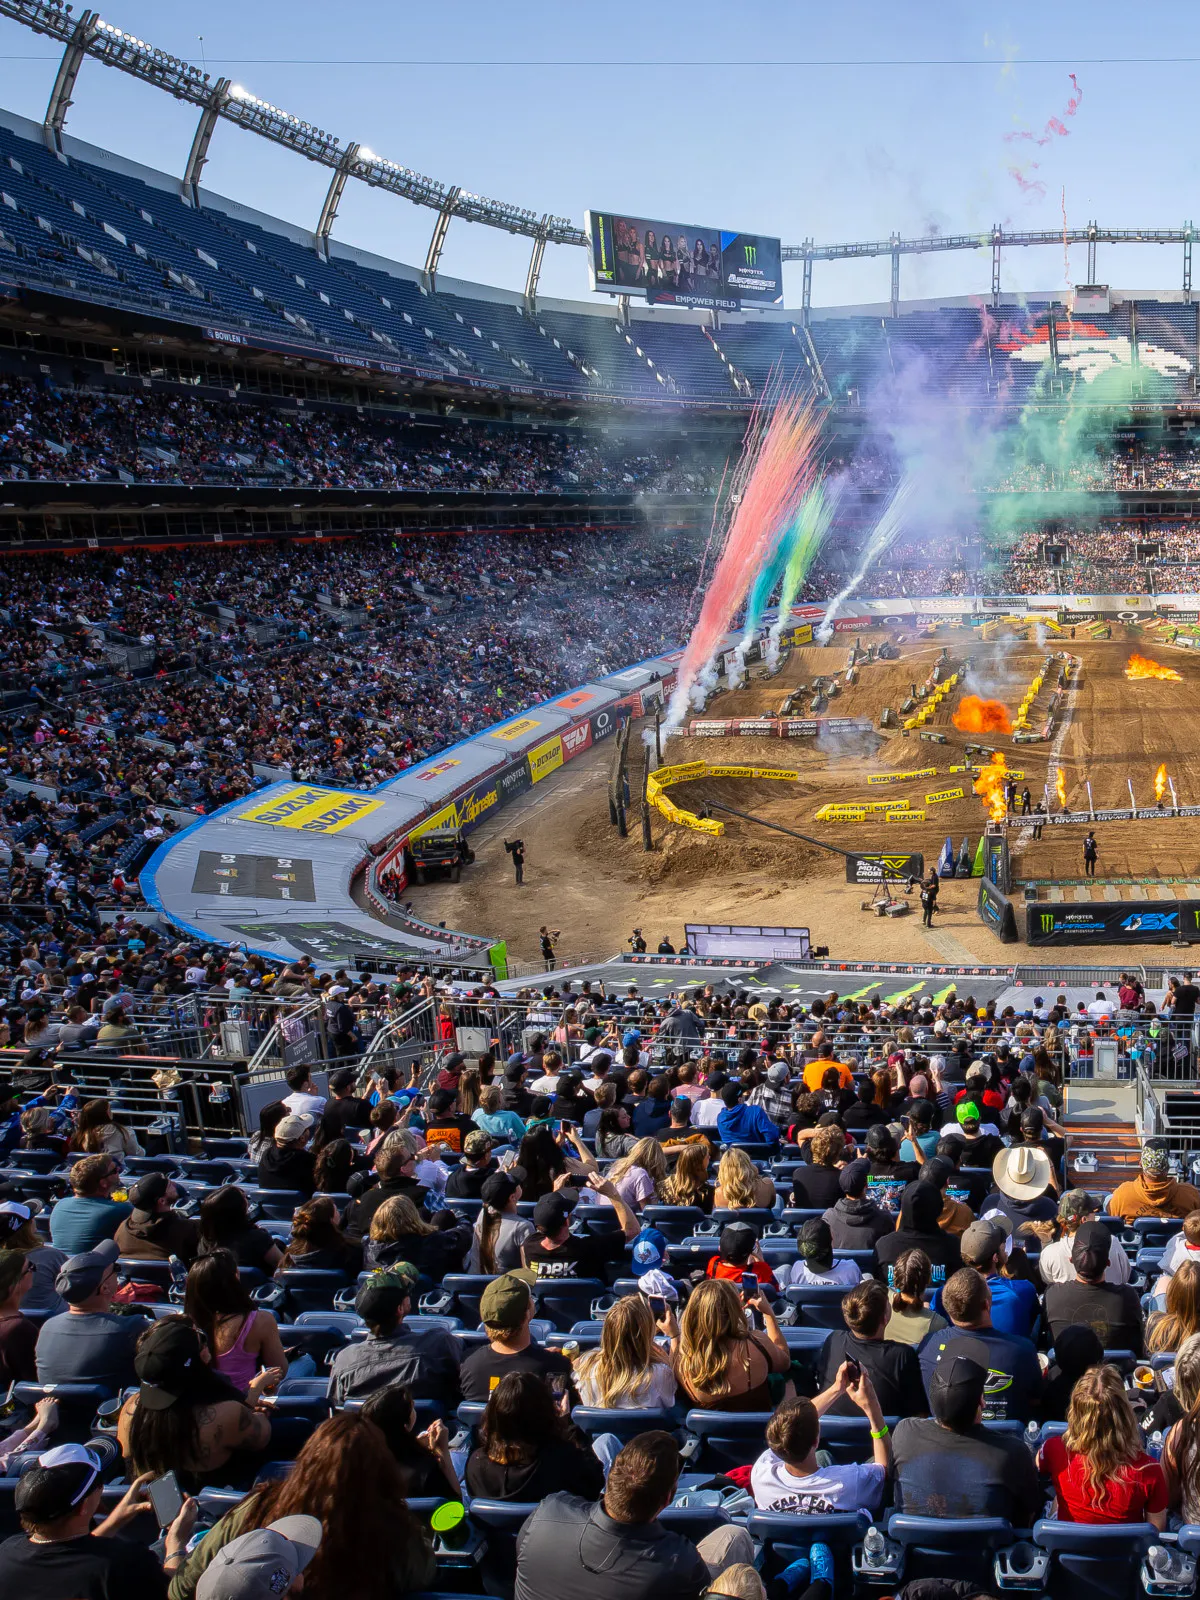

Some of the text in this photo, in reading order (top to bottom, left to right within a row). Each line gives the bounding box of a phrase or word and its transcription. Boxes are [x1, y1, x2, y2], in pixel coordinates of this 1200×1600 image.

[675, 295, 737, 308] EMPOWER FIELD
[215, 331, 241, 343] BOWLEN
[563, 723, 589, 749] FLY
[595, 724, 613, 740] OAKLEY
[536, 745, 561, 768] DUNLOP
[501, 765, 526, 787] MONSTER
[871, 775, 900, 783] SUZUKI
[928, 790, 961, 801] SUZUKI
[255, 788, 332, 823] SUZUKI
[301, 797, 373, 832] SUZUKI
[468, 789, 498, 824] alpinestars
[873, 803, 907, 811] SUZUKI
[767, 1494, 807, 1512] NEAKY
